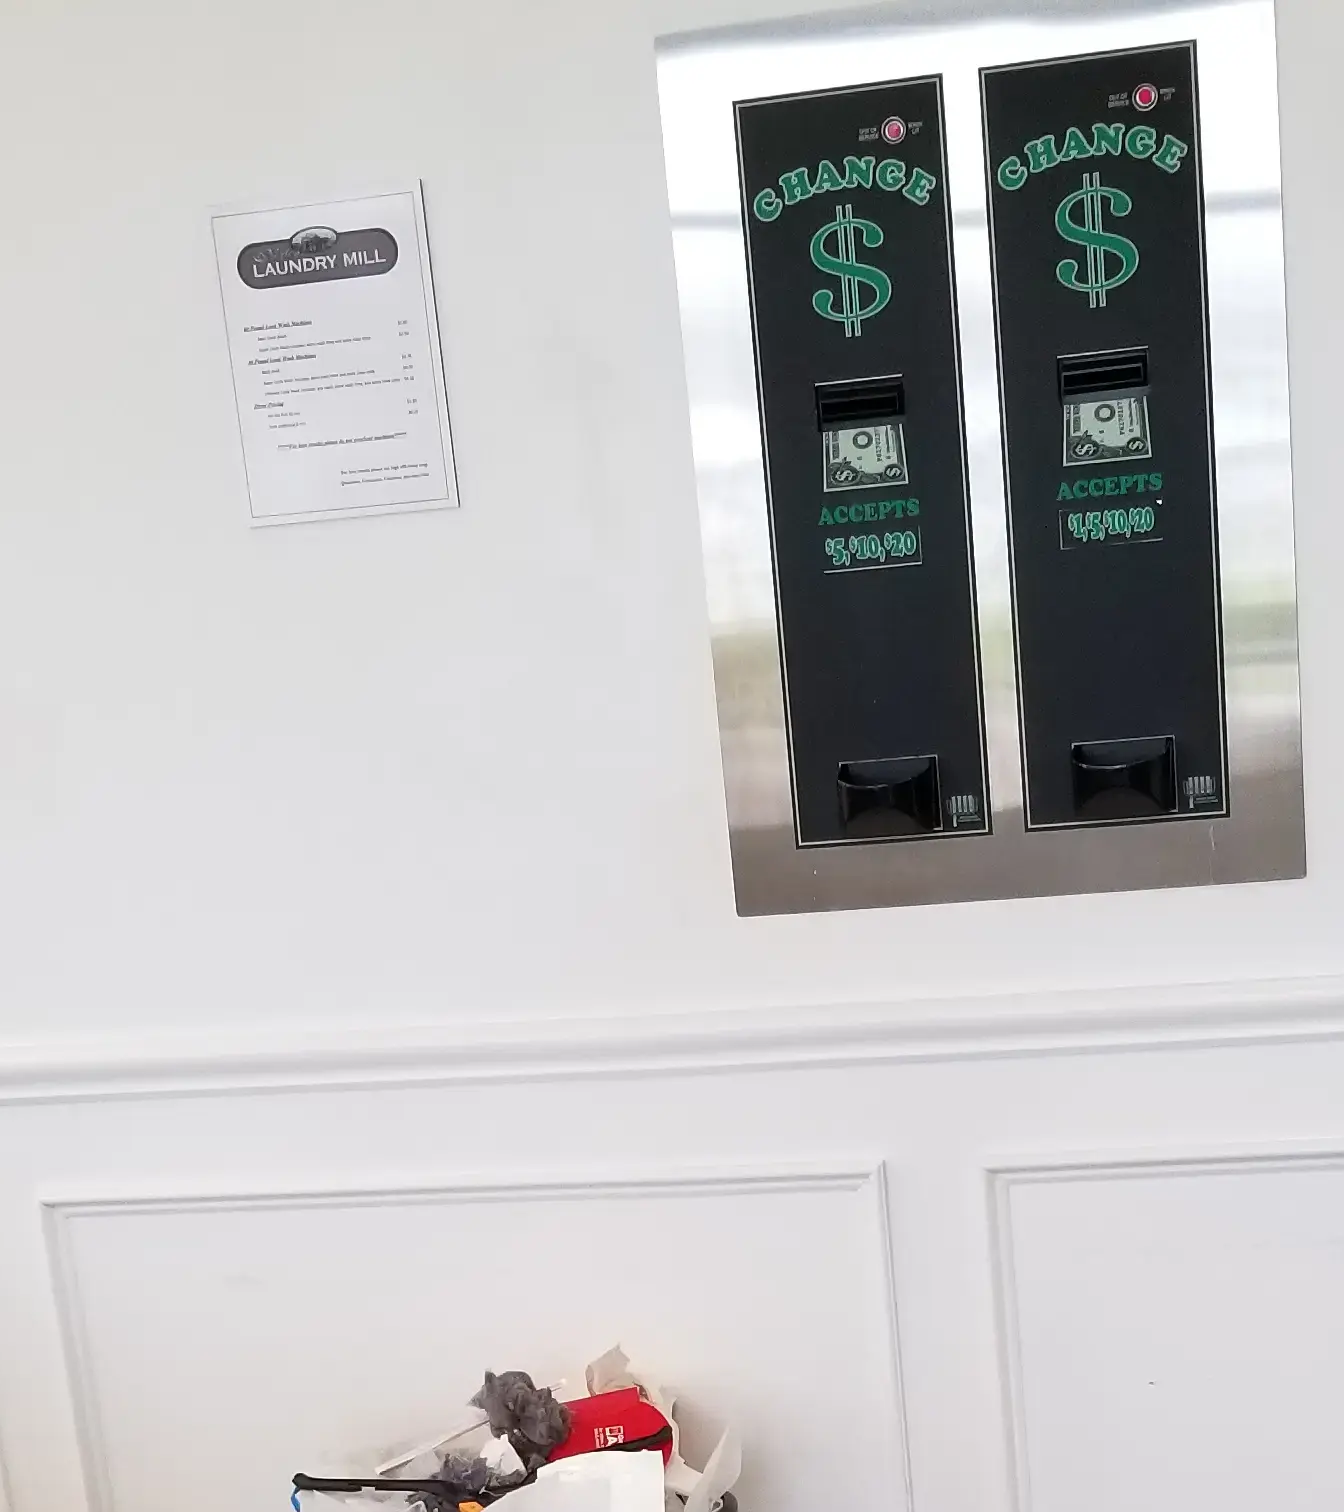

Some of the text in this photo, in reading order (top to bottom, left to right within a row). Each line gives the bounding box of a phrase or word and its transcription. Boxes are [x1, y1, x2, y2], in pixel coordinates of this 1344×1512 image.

[998, 123, 1187, 190] CHANGE
[754, 156, 936, 222] CHANGE
[252, 255, 337, 278] LAUNDRY
[343, 248, 387, 268] MILL
[1056, 472, 1163, 501] ACCEPTS
[818, 498, 920, 526] ACCEPTS
